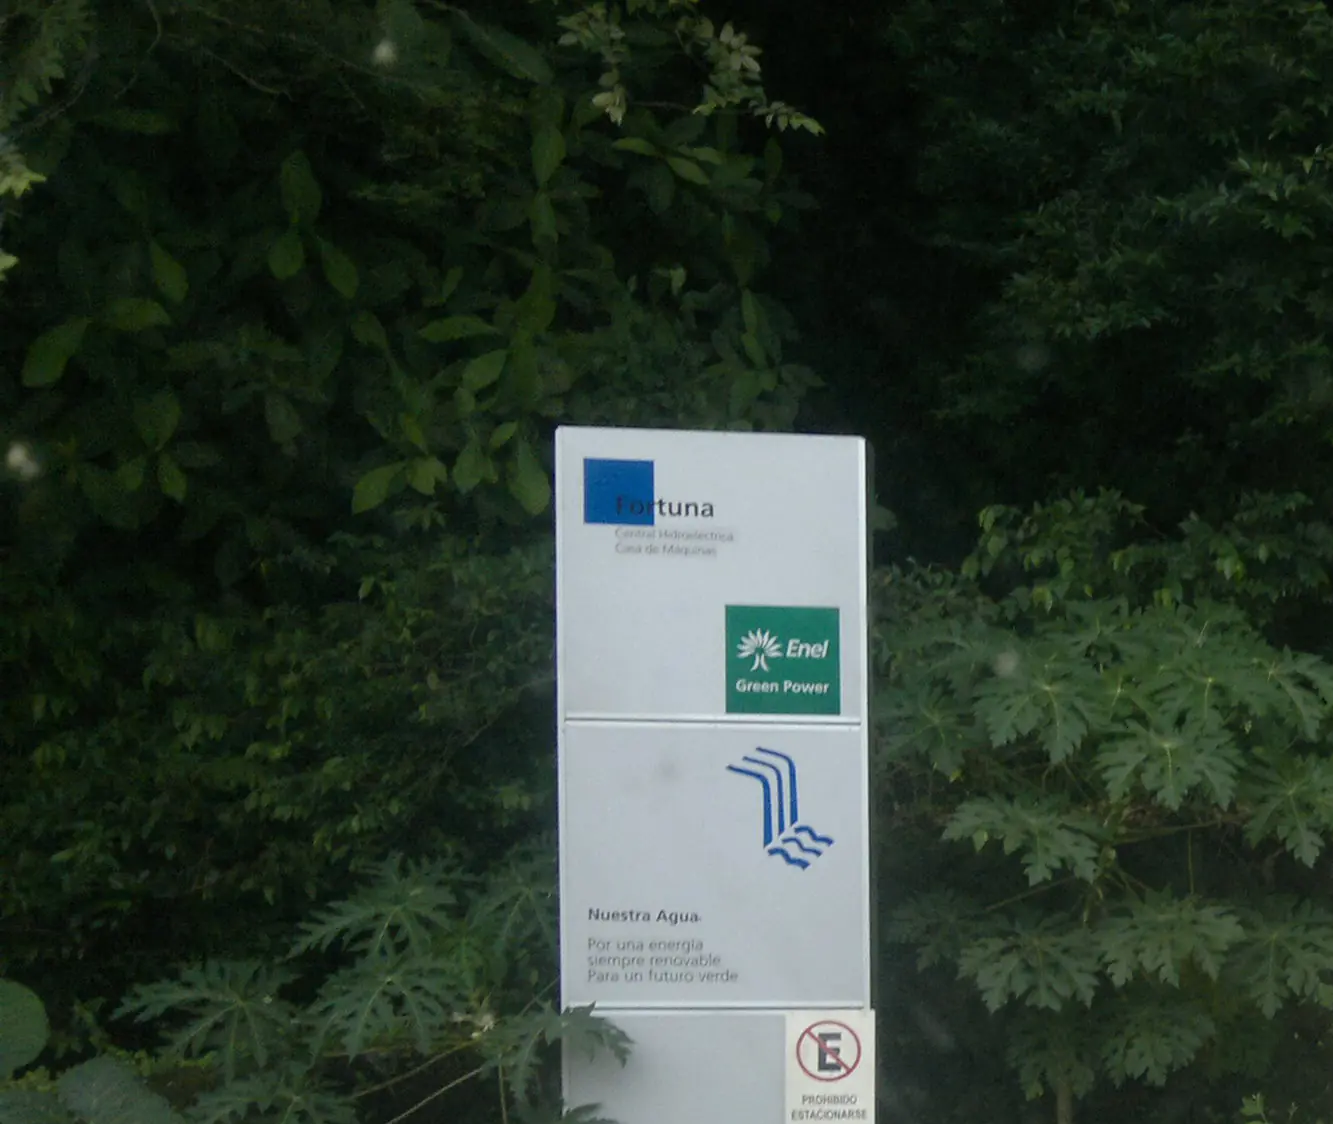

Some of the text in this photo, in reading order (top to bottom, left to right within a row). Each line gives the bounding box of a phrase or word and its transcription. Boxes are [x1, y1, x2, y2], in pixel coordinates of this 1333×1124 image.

[616, 495, 715, 518] Fortuna
[645, 543, 659, 554] de
[786, 638, 829, 658] Enel
[735, 679, 829, 694] Green Power
[588, 908, 651, 922] Nuestra
[588, 938, 612, 951] Por
[616, 941, 644, 951] una
[587, 953, 721, 969] siempre renovable
[588, 970, 738, 982] Para un futuro verde
[801, 1094, 858, 1105] PROHIBIDO
[791, 1109, 867, 1121] ESTACIONARSE
